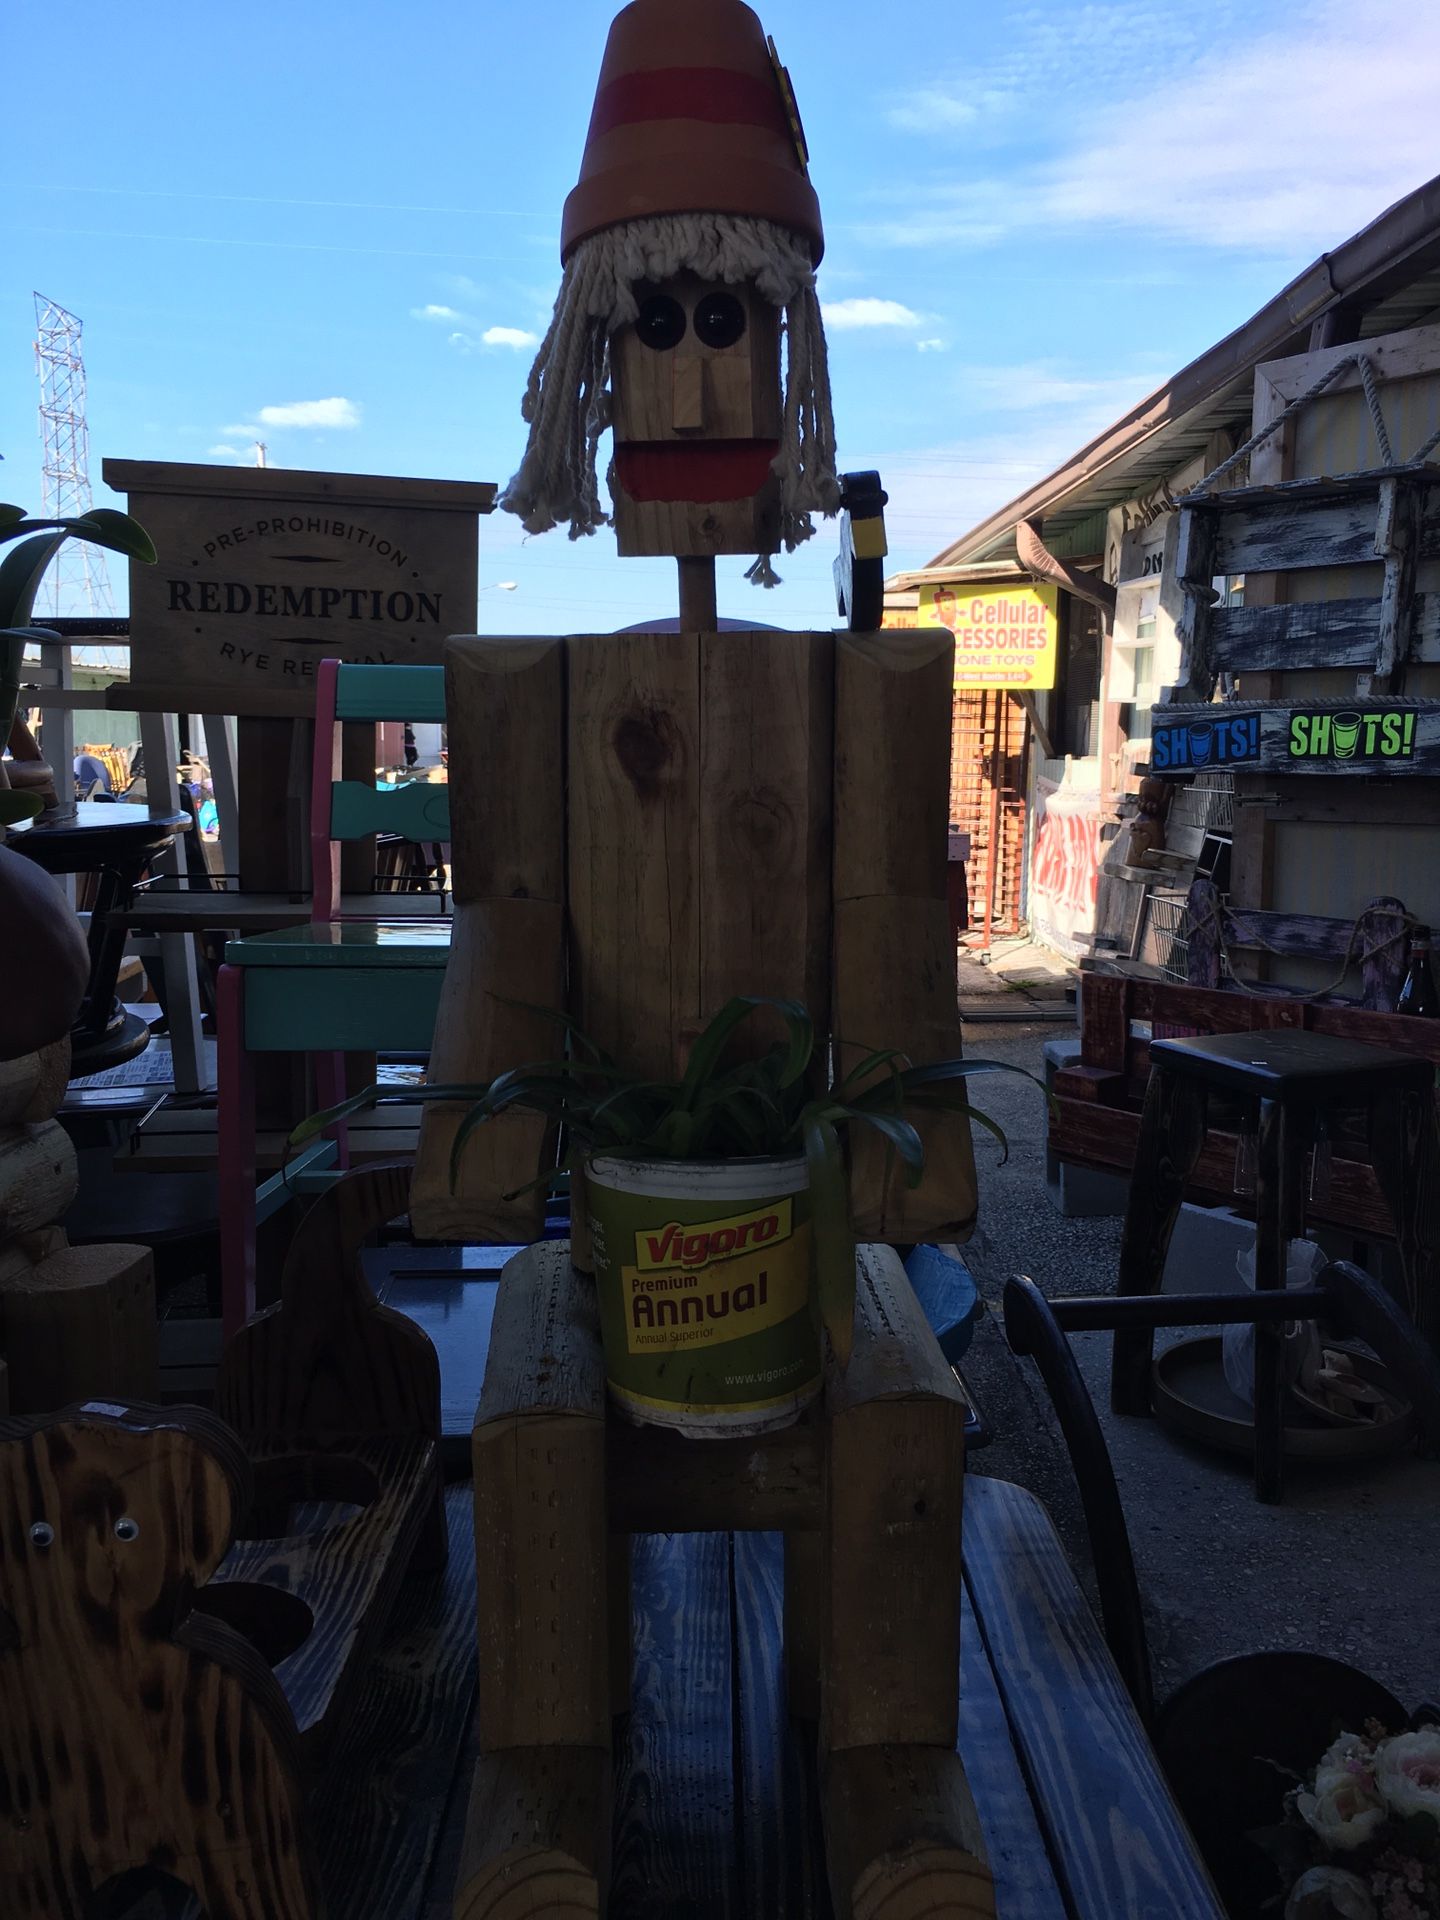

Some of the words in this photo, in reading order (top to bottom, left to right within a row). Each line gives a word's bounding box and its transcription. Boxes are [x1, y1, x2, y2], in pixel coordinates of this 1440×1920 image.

[203, 516, 408, 568] PRE-PROHIBITION
[166, 579, 443, 623] REDEMPTION
[970, 599, 1049, 625] Cellular
[219, 641, 270, 670] RYE
[994, 654, 1035, 666] TOYS
[646, 1214, 780, 1266] Vigoro
[632, 1275, 698, 1293] Premium
[633, 1271, 768, 1328] Annual
[635, 1331, 667, 1345] Annual
[670, 1327, 715, 1344] Superior
